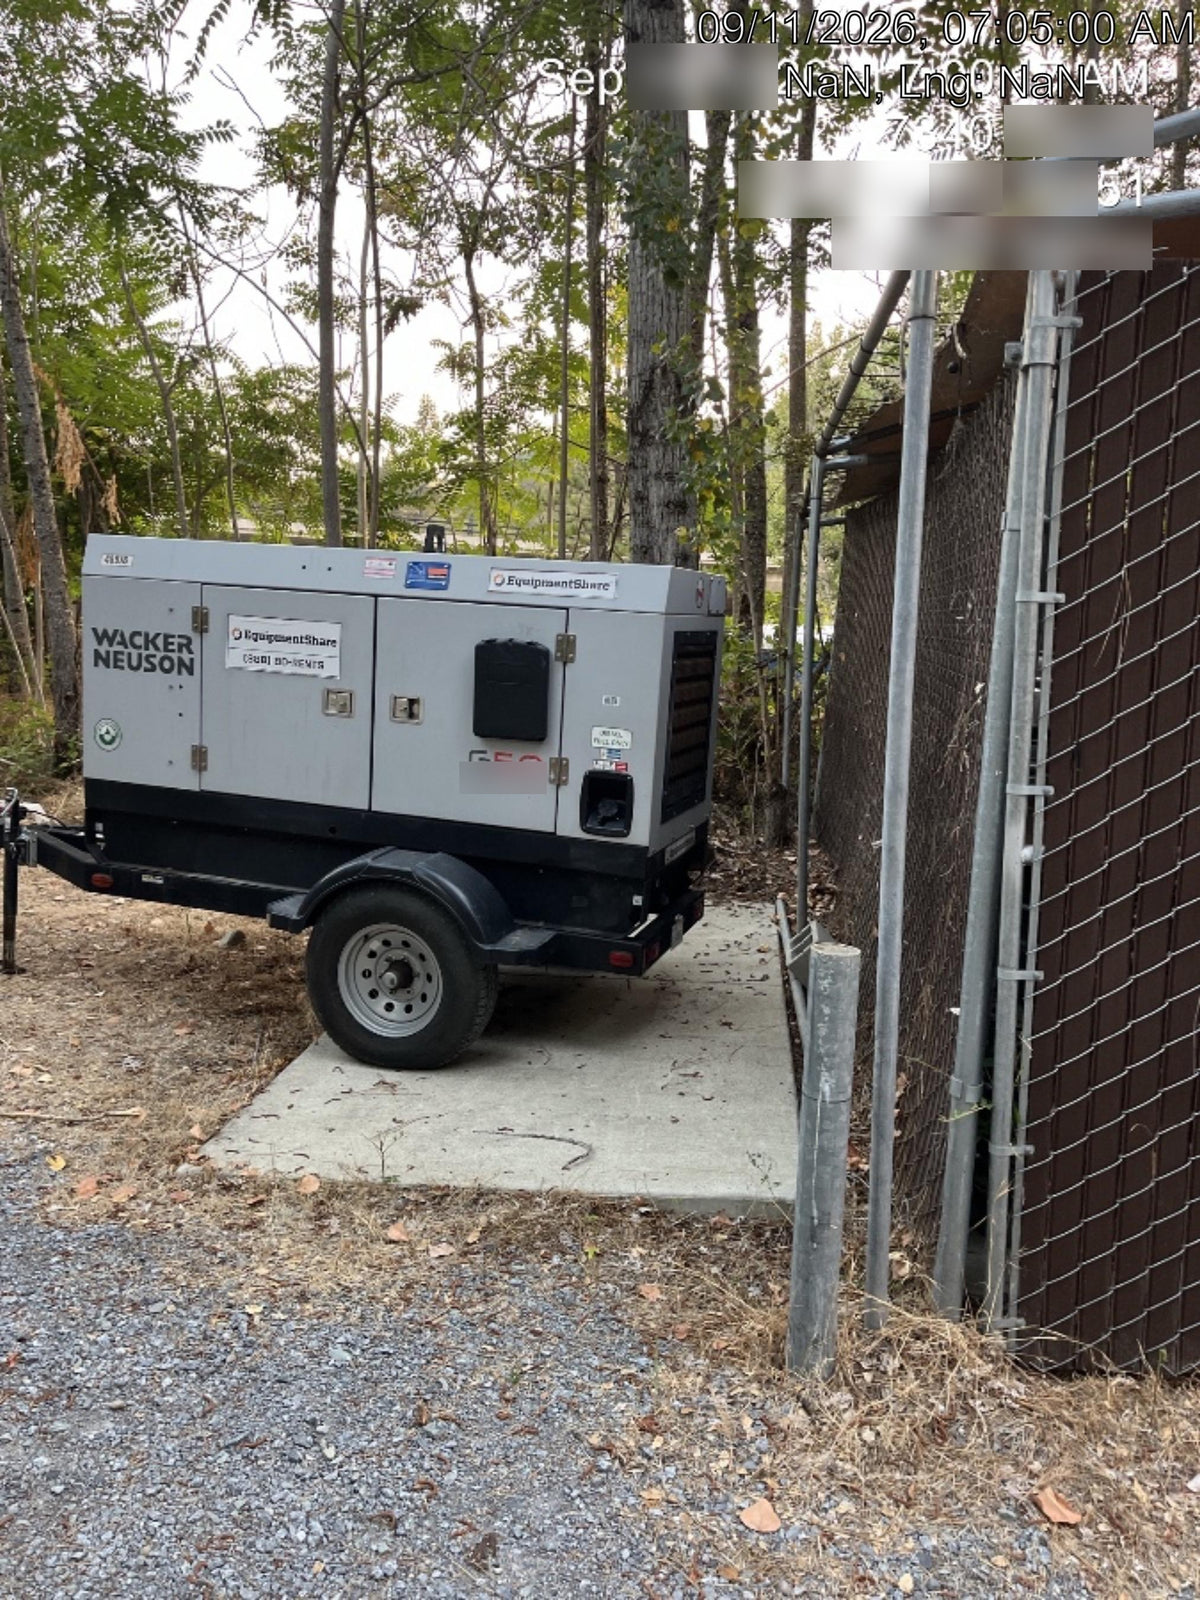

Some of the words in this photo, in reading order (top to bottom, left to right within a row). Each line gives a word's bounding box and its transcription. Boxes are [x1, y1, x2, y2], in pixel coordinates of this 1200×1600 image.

[91, 626, 195, 655] WACKER
[244, 628, 338, 648] EquipmentShare
[93, 648, 195, 677] NEUSON
